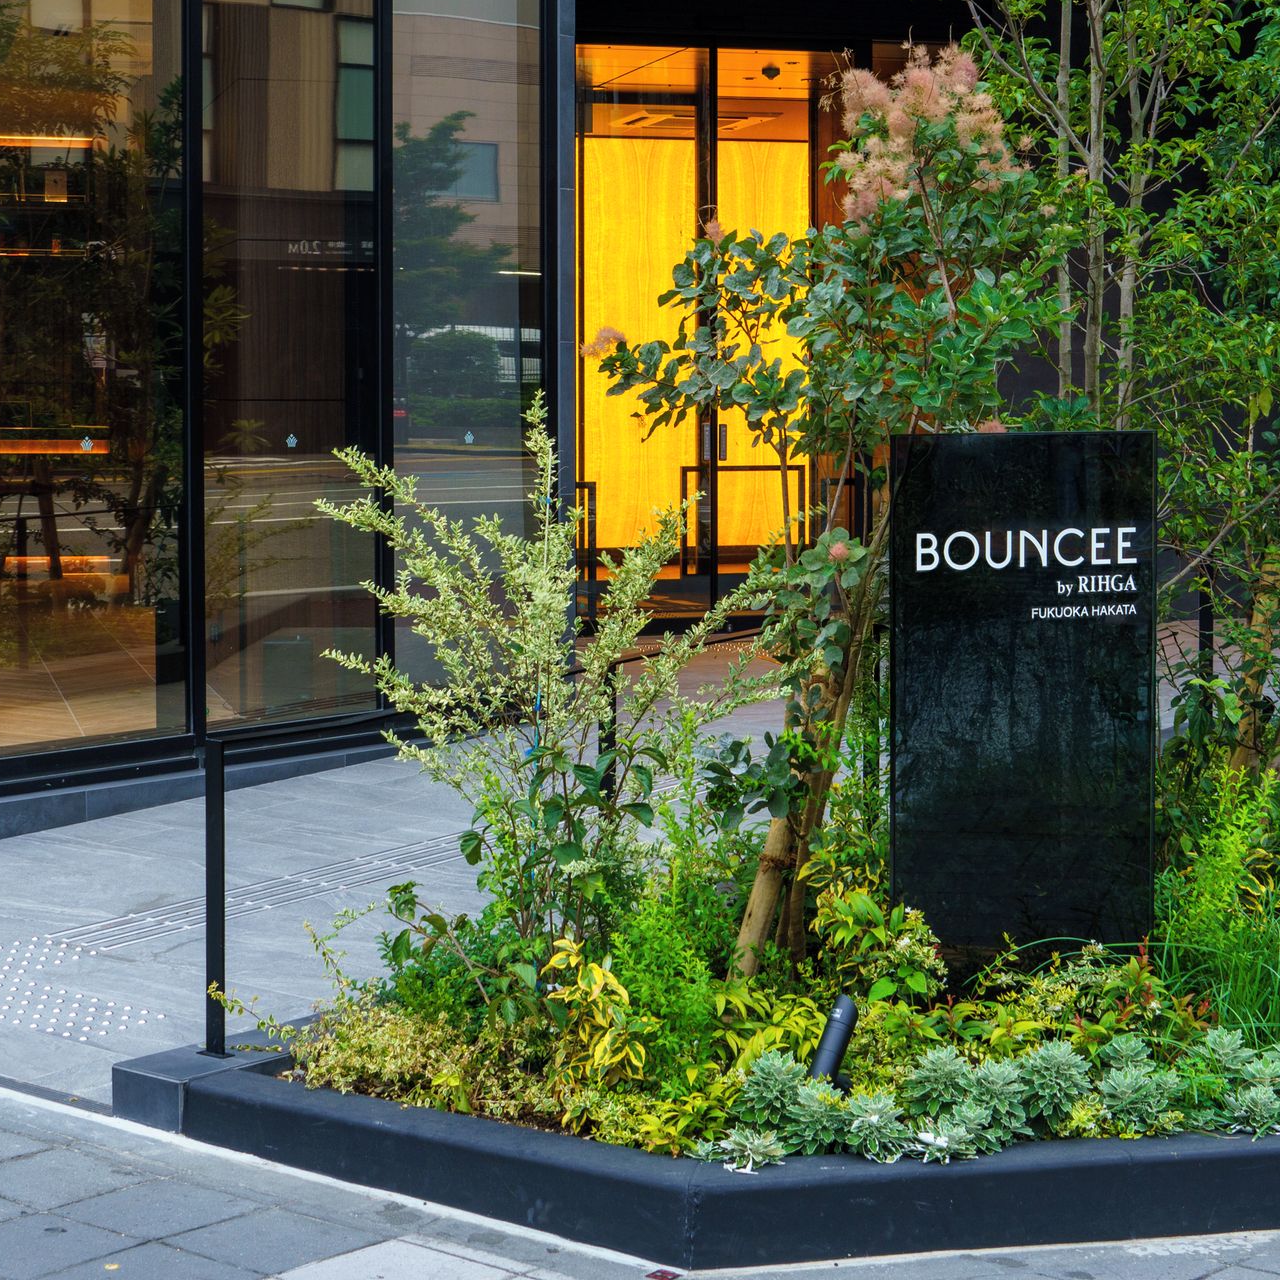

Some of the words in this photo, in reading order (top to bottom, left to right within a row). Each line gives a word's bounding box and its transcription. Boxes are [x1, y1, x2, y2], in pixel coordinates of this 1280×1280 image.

[916, 526, 1138, 572] BOUNCEE
[1056, 580, 1074, 596] by
[1078, 574, 1137, 594] RIHGA
[1031, 605, 1089, 620] FUKUOKA
[1091, 603, 1137, 618] HAKATA
